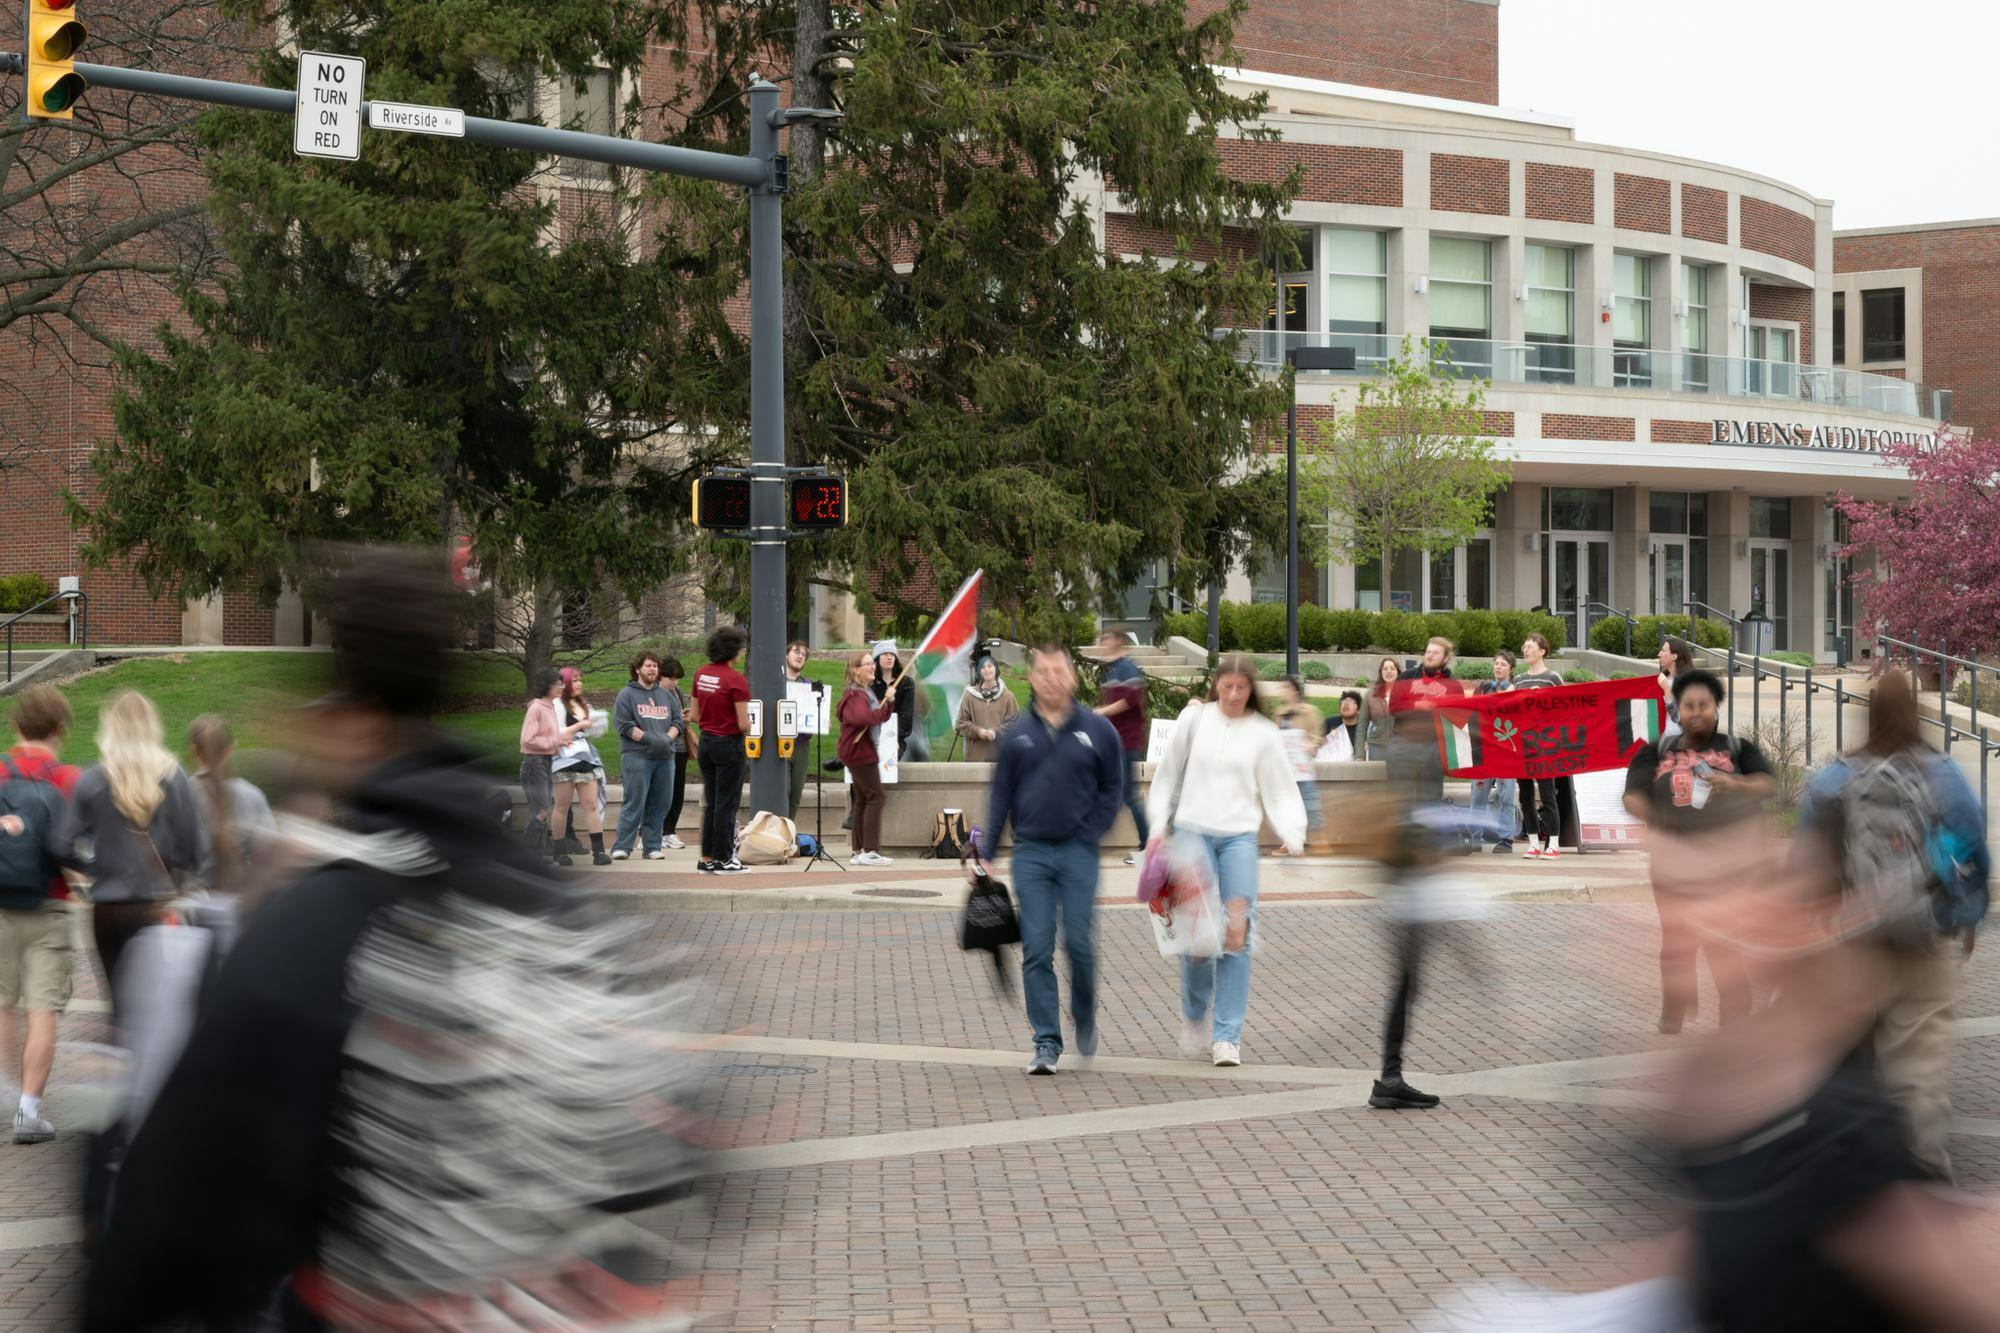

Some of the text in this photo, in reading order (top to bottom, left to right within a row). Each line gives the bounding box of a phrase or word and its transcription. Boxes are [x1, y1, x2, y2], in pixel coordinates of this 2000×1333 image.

[318, 63, 345, 83] NO
[313, 87, 347, 106] TURN
[319, 109, 338, 127] ON
[383, 108, 453, 128] Riverside Av
[314, 131, 341, 149] RED
[1712, 419, 1939, 455] EMENS AUDITORIUM
[816, 486, 841, 519] 22
[1487, 694, 1599, 716] FREE PALESTINE
[1521, 724, 1587, 759] BSU
[1526, 754, 1590, 776] DIVEST
